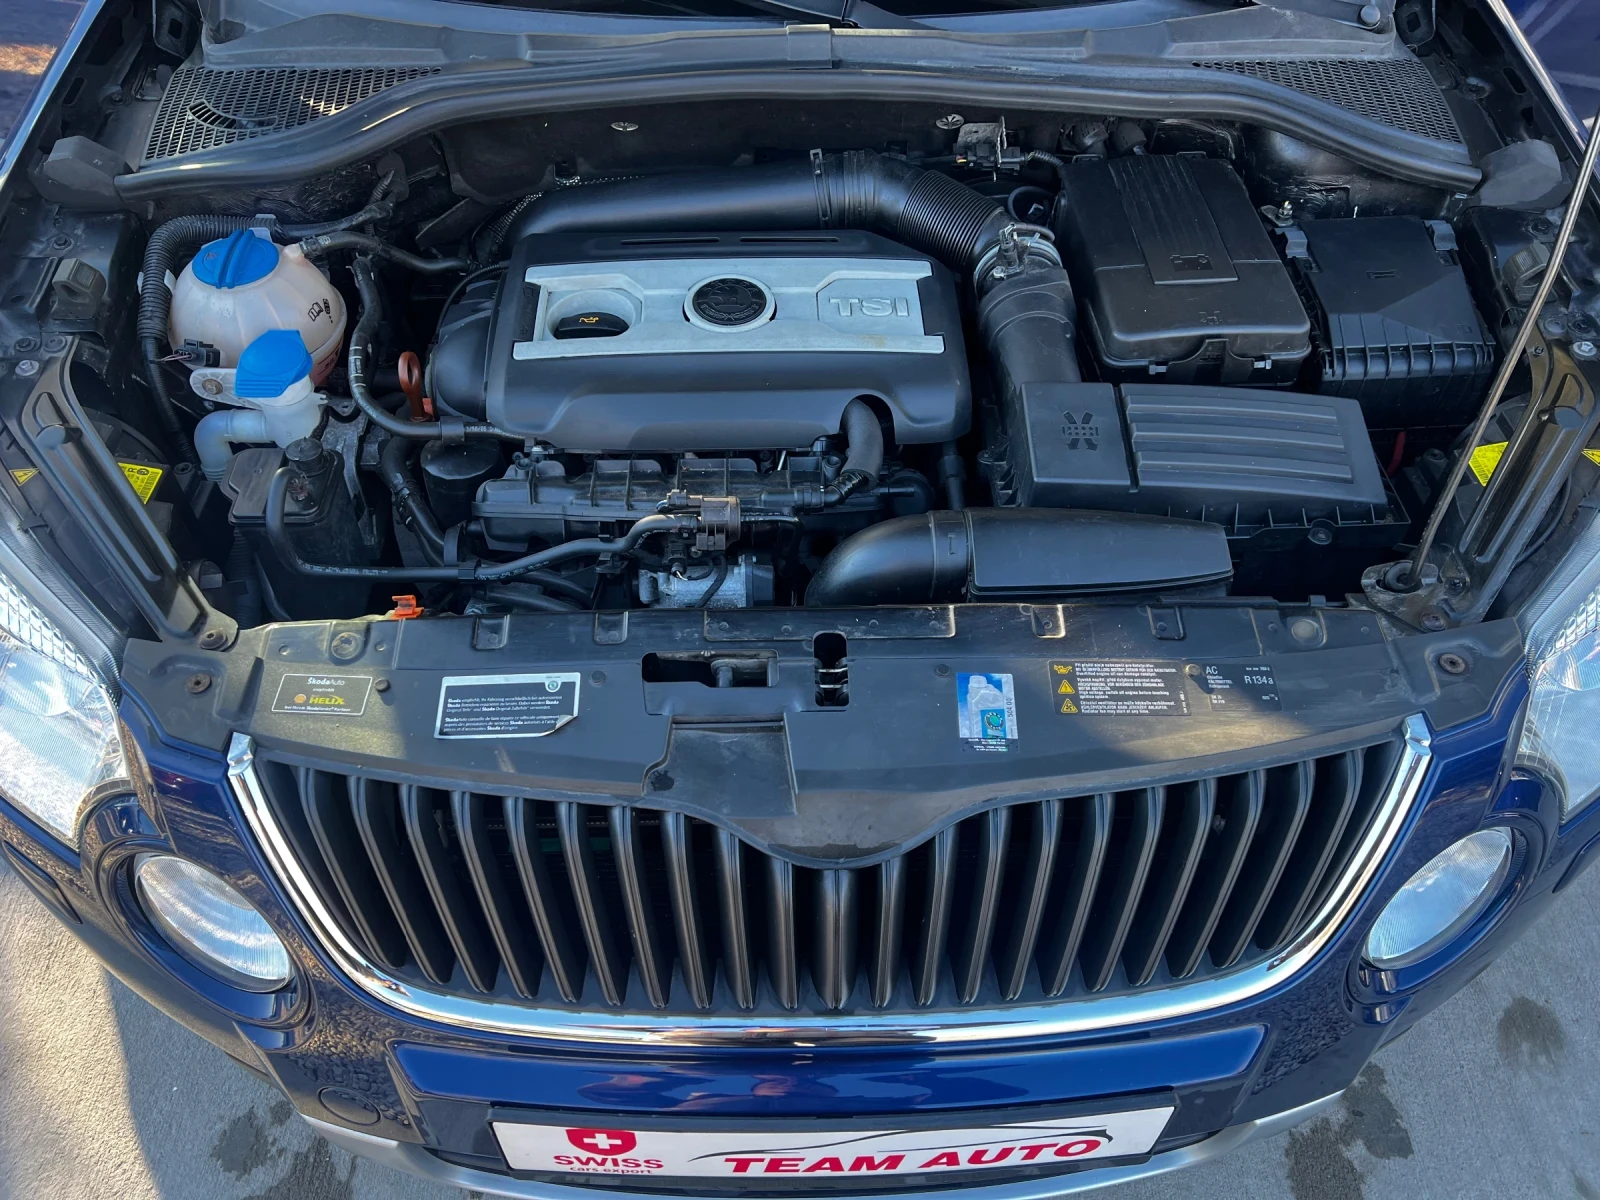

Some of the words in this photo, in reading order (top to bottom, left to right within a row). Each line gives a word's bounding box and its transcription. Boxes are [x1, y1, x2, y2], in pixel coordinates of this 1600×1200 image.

[829, 297, 909, 317] TSI
[1206, 666, 1218, 674] AC
[309, 694, 345, 704] HELIX
[553, 1155, 664, 1169] SWISS
[724, 1154, 906, 1173] TEAM
[918, 1139, 1102, 1169] AUTO
